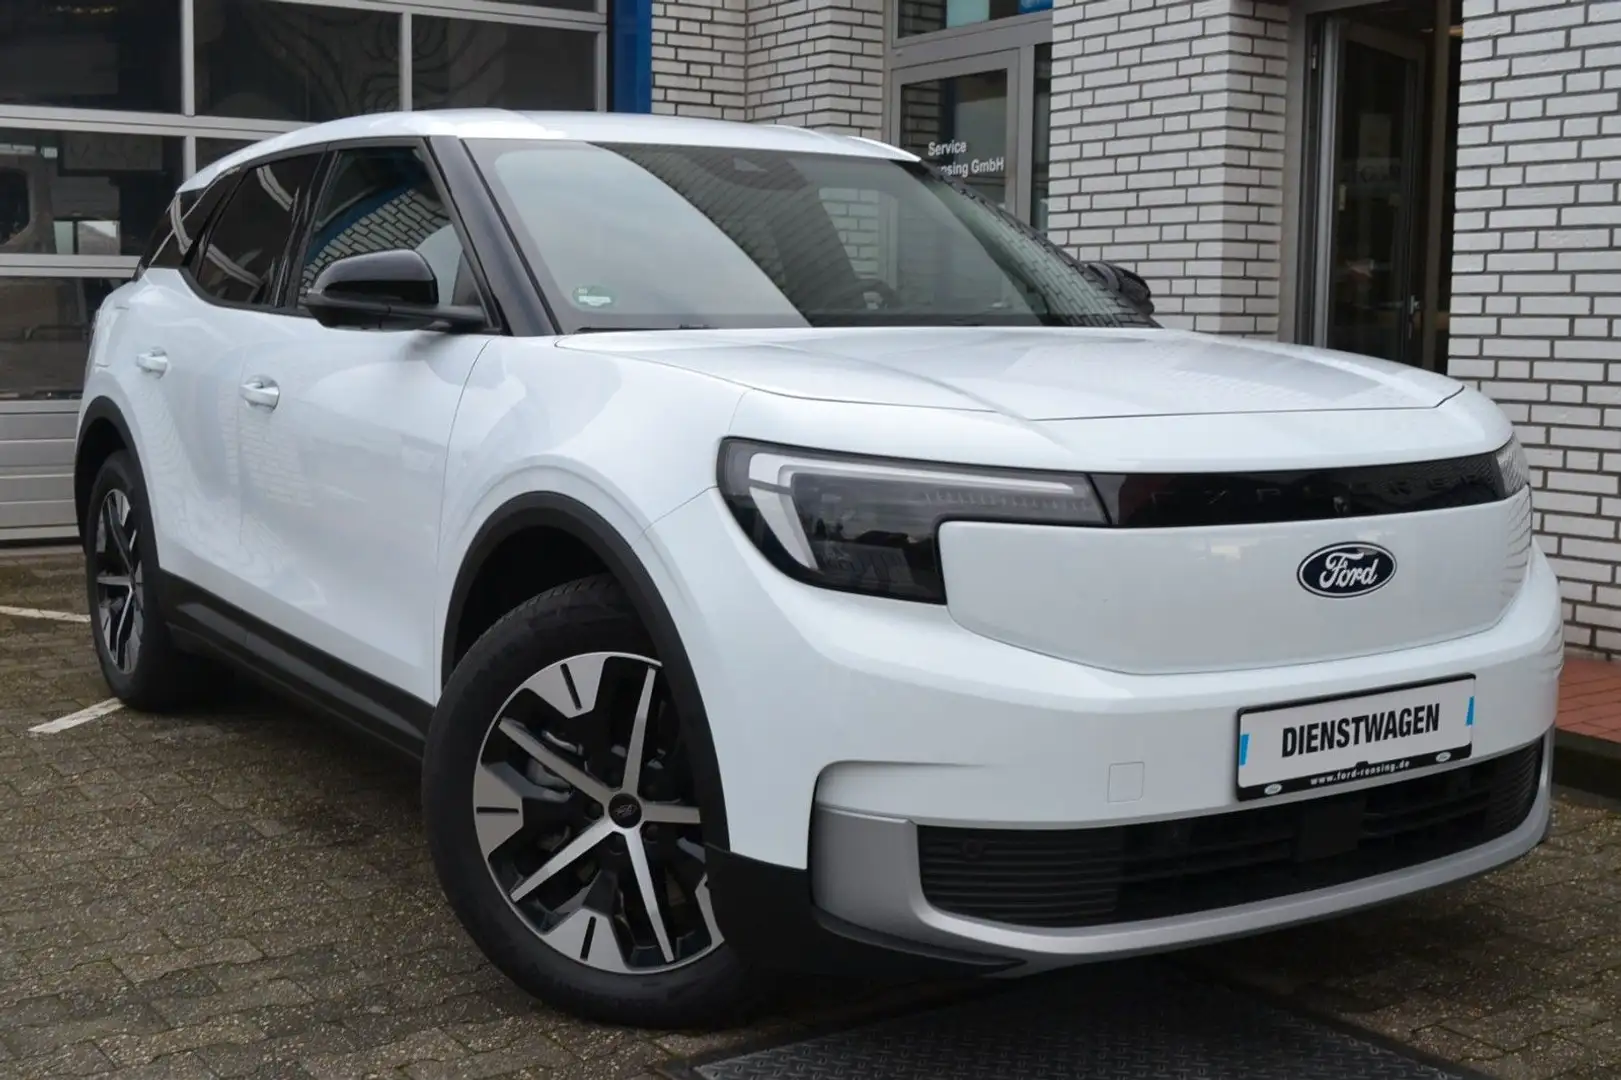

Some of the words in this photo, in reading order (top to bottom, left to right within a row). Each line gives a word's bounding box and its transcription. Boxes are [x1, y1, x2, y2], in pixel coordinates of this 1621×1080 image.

[927, 140, 967, 156] Service
[971, 157, 1005, 174] GmbH
[1281, 702, 1440, 758] DIENSTWAGEN
